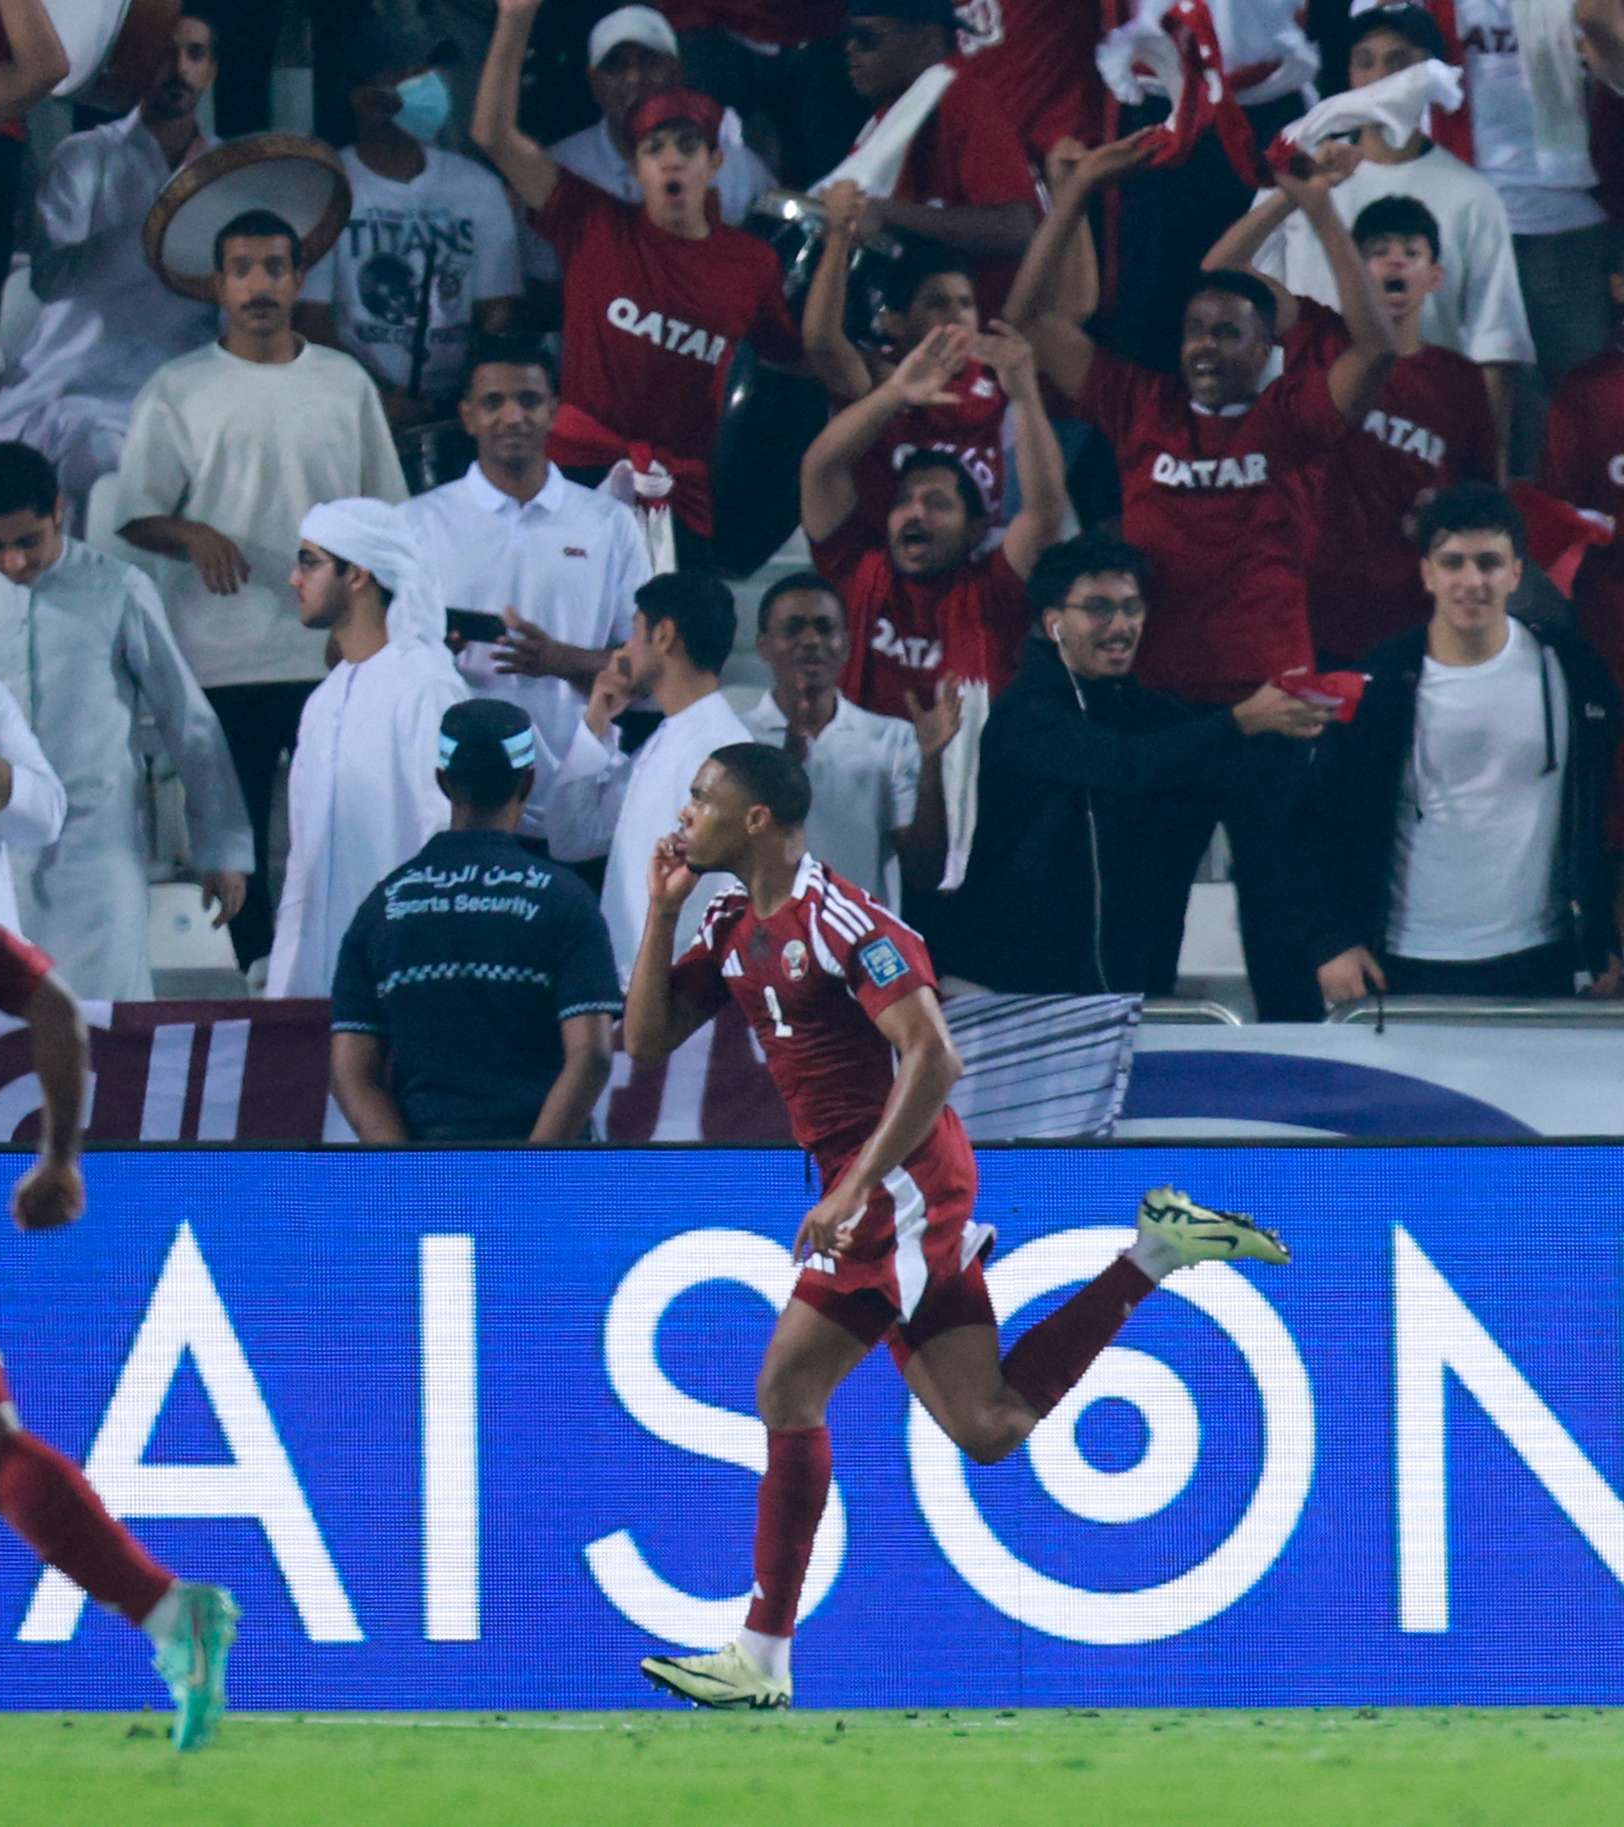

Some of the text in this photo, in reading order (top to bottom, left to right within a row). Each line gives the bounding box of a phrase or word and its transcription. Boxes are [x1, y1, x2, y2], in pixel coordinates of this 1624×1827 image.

[346, 218, 474, 258] TITANS
[1151, 452, 1268, 489] QATAR
[384, 892, 541, 922] Sports Security
